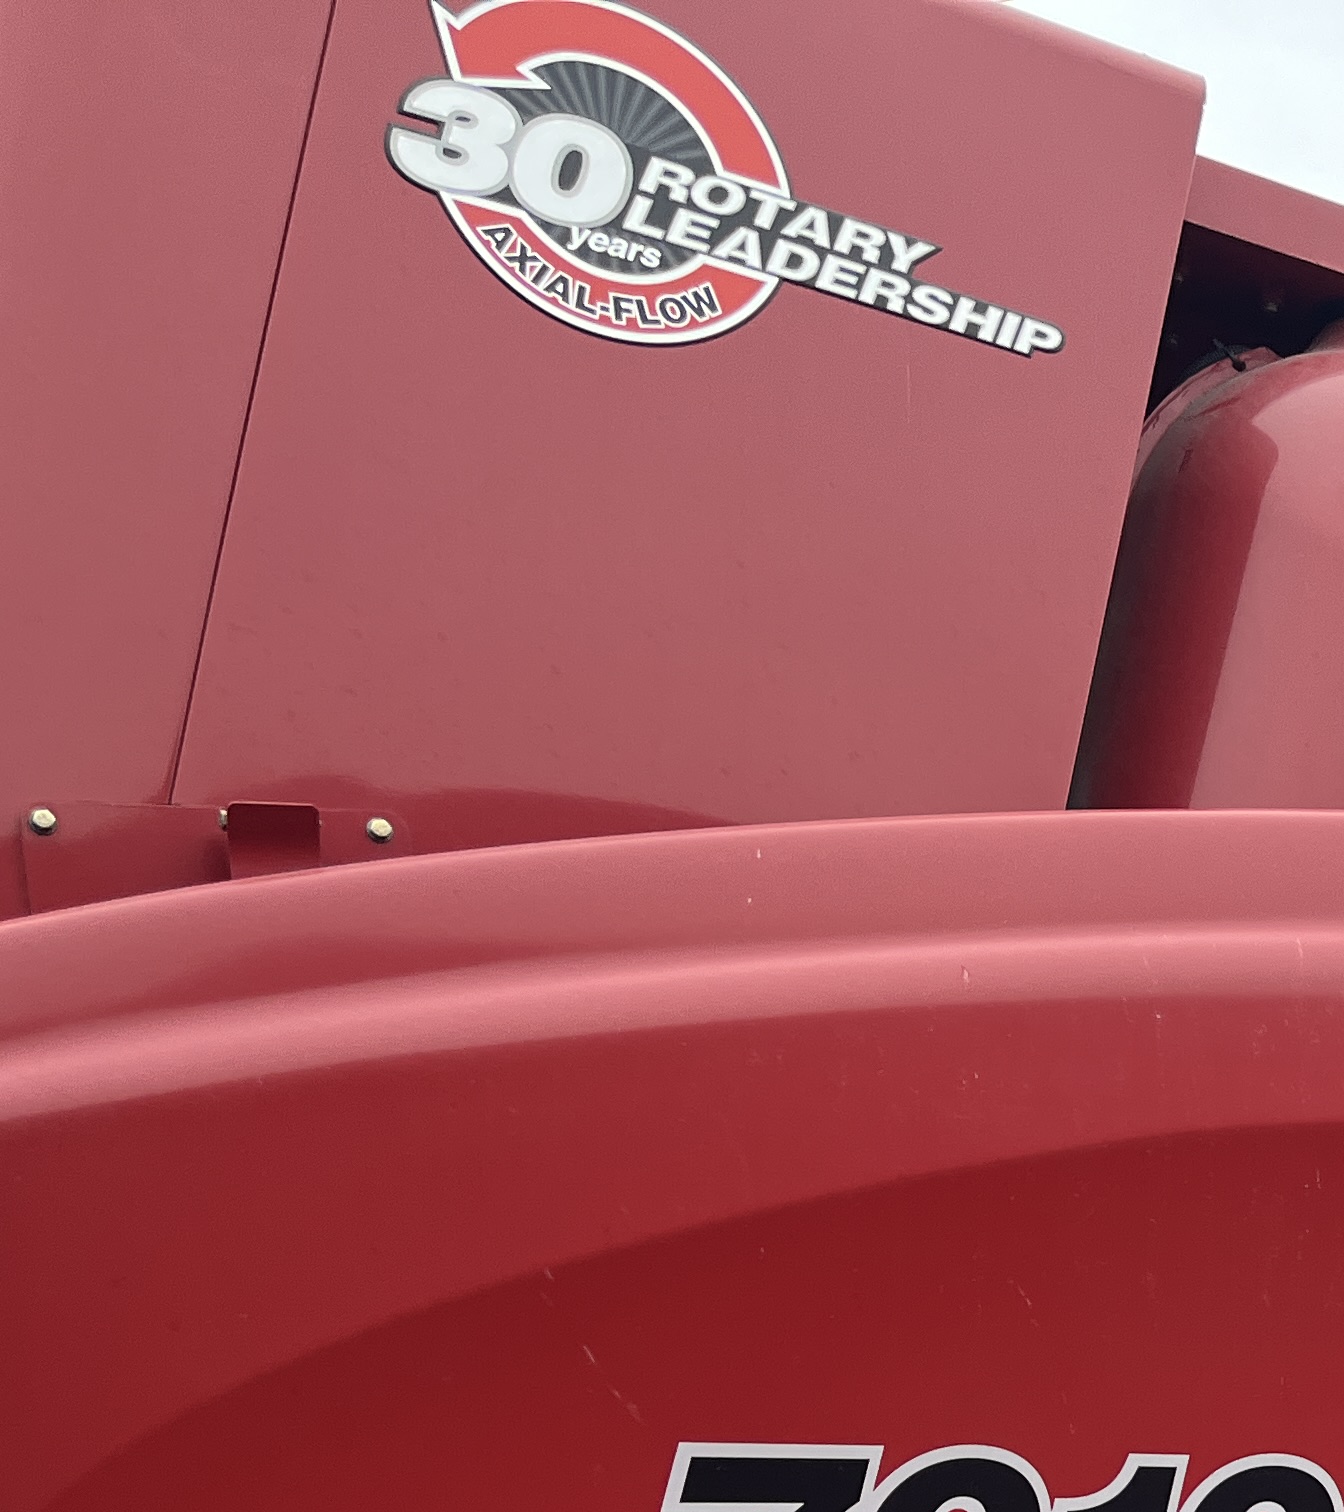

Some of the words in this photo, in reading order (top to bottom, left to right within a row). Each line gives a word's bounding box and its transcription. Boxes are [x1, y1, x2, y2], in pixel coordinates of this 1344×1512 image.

[387, 79, 634, 226] 30
[567, 223, 663, 268] years
[622, 193, 1065, 357] LEADERSHIP
[638, 155, 938, 275] ROTARY
[477, 222, 722, 329] AXIAL-FLOW
